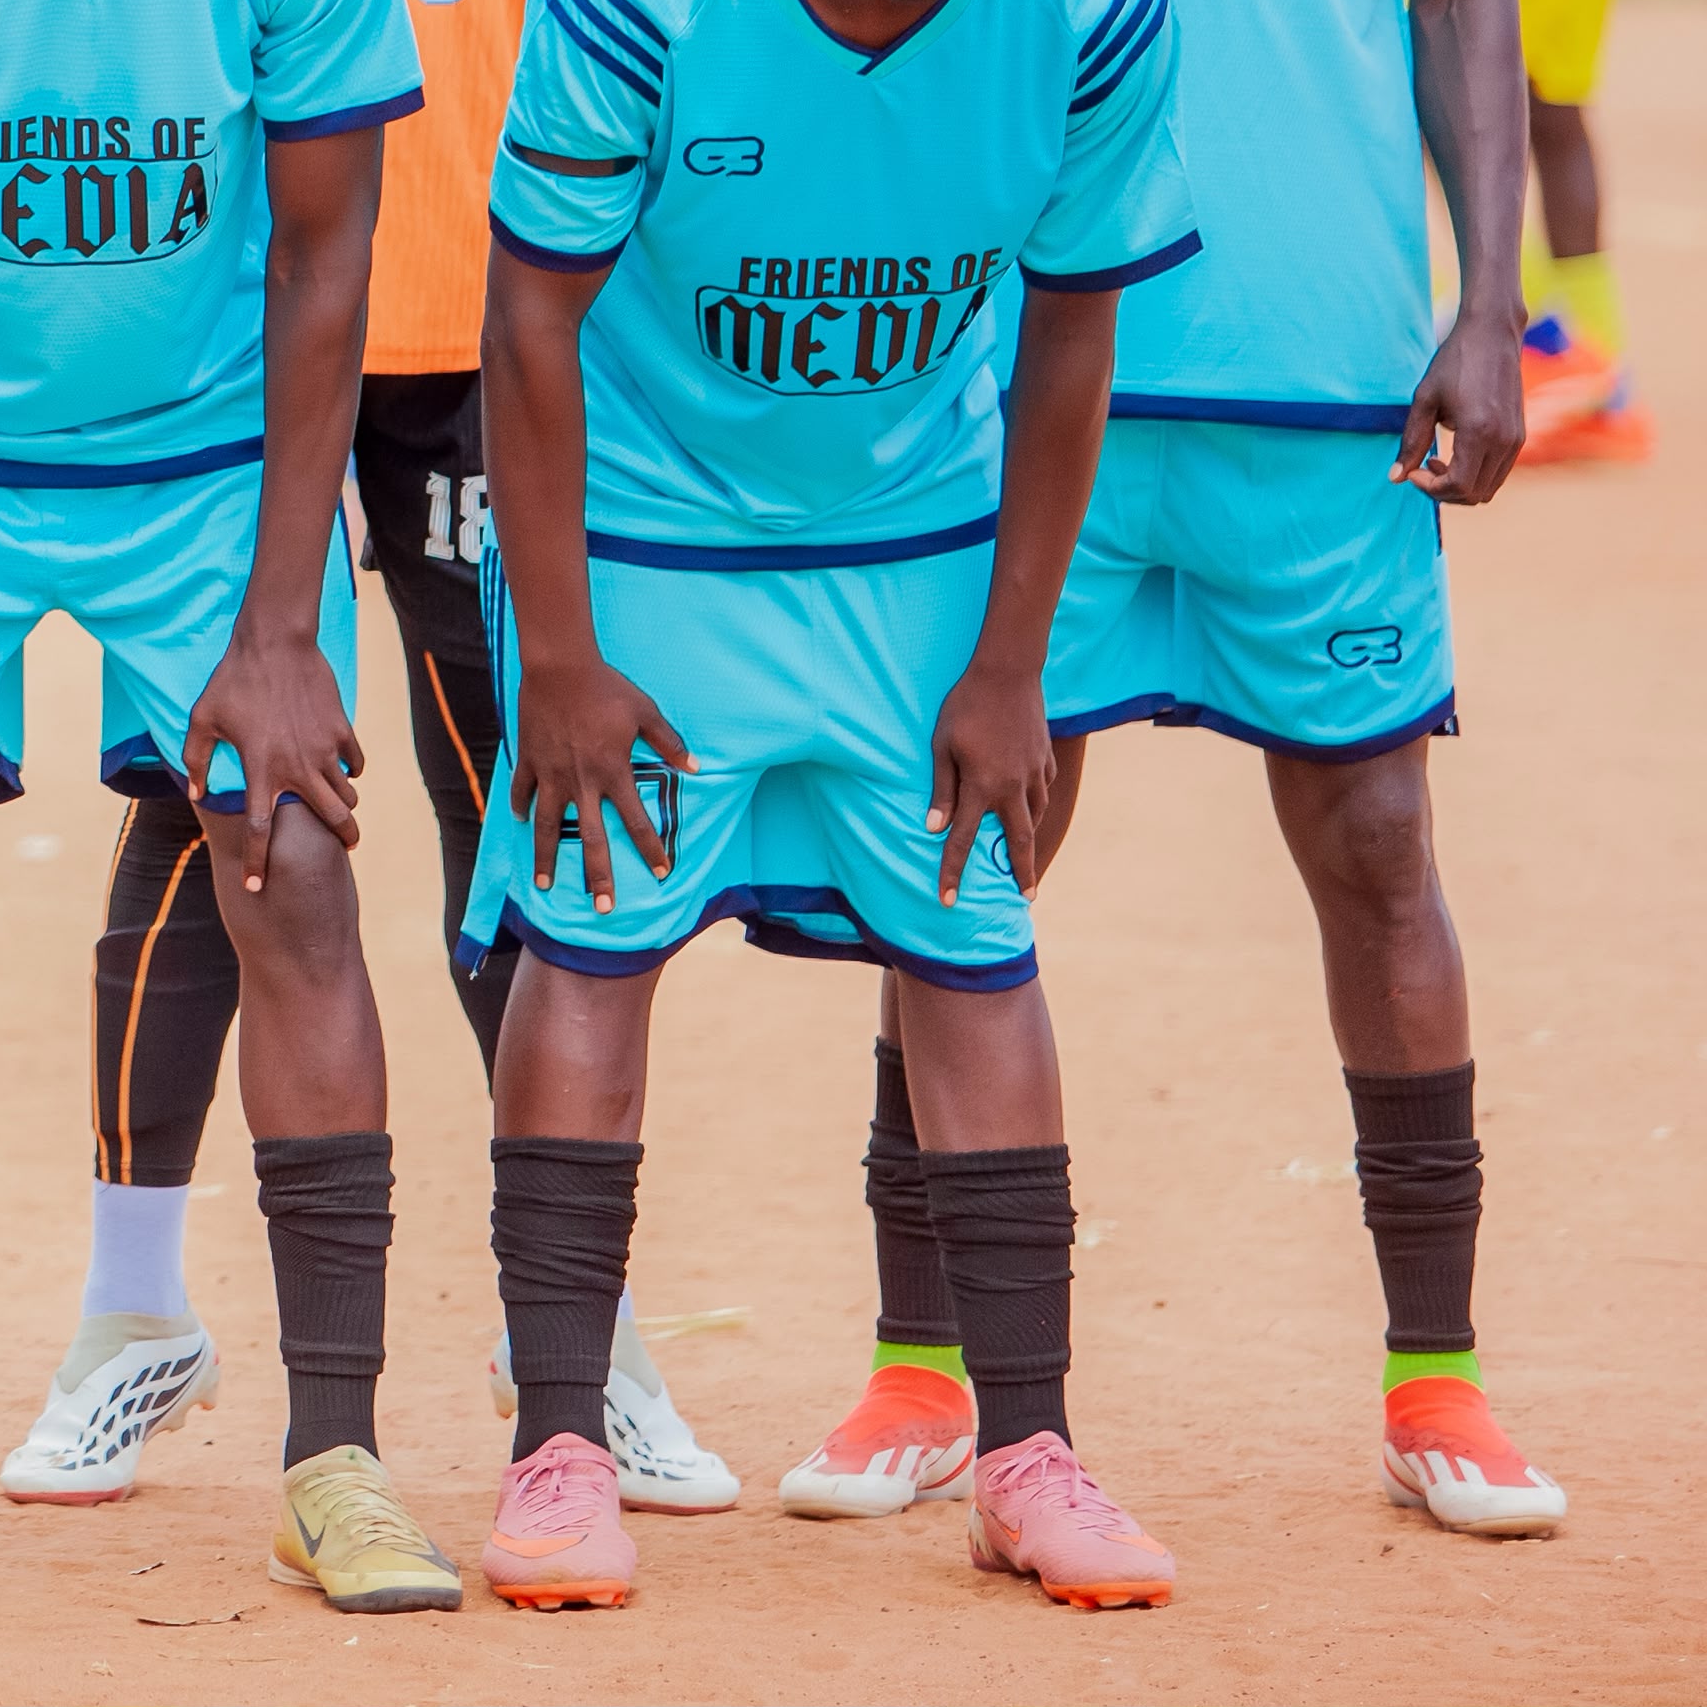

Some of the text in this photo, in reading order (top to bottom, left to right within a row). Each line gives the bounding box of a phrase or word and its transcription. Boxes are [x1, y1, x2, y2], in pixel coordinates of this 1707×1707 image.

[152, 117, 206, 160] OF
[738, 247, 1003, 297] FRIENDS OF
